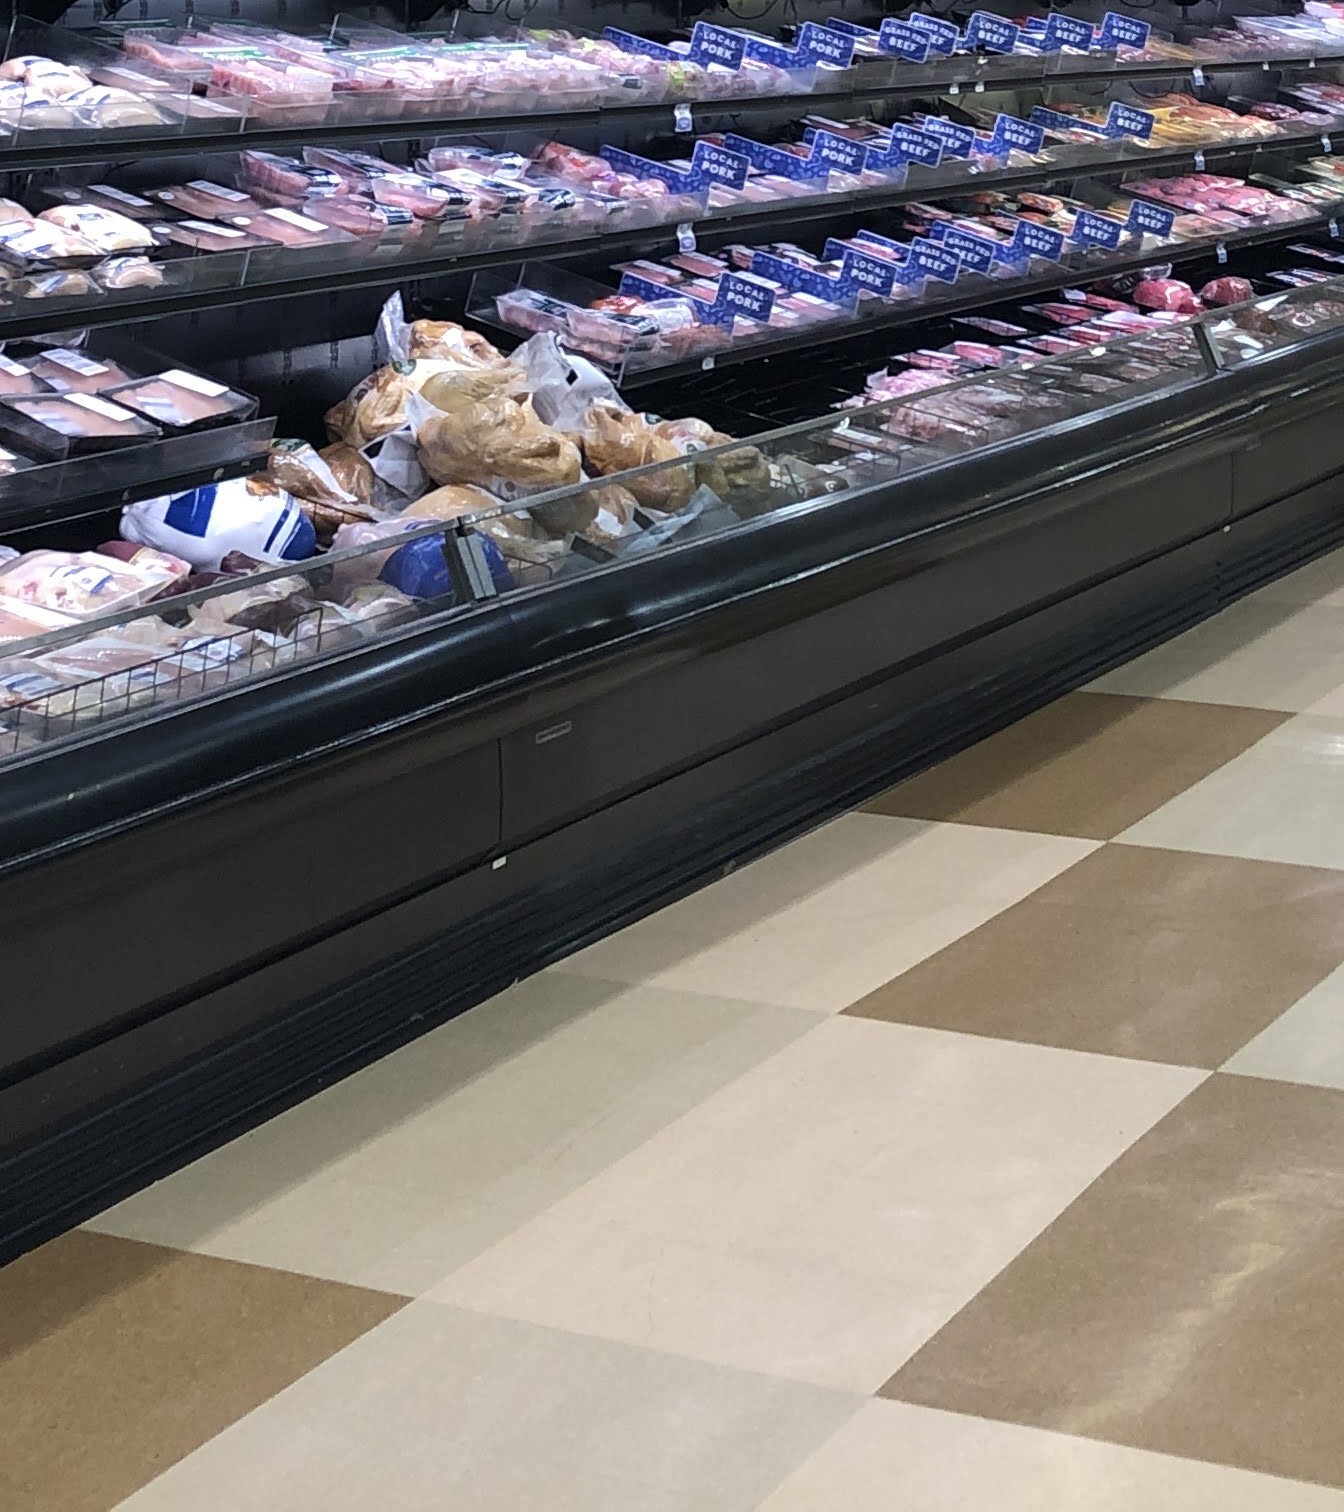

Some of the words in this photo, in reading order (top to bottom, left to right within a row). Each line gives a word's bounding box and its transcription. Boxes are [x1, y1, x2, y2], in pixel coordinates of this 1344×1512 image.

[978, 20, 1010, 37] LOCAL
[1056, 20, 1087, 35] LOCAL
[1113, 18, 1141, 34] LOCAL
[703, 31, 737, 49] LOCAL
[811, 30, 845, 48] LOCAL
[977, 29, 1007, 45] BEEF
[1055, 29, 1082, 43] BEEF
[1111, 28, 1138, 41] BEEF
[700, 41, 734, 60] PORK
[809, 40, 842, 59] PORK
[889, 37, 917, 52] BEEF
[1117, 108, 1147, 123] LOCAL
[1005, 122, 1036, 139] LOCAL
[1116, 117, 1144, 132] BEEF
[823, 137, 856, 155] LOCAL
[1004, 131, 1032, 146] BEEF
[821, 147, 854, 166] PORK
[900, 141, 931, 158] BEEF
[703, 149, 739, 169] LOCAL
[701, 161, 736, 180] PORK
[1138, 206, 1168, 222] LOCAL
[1084, 217, 1117, 233] LOCAL
[1137, 215, 1163, 230] BEEF
[1024, 227, 1056, 243] LOCAL
[1083, 226, 1110, 241] BEEF
[1023, 236, 1052, 252] BEEF
[853, 258, 886, 276] LOCAL
[918, 256, 947, 272] BEEF
[850, 269, 883, 287] PORK
[729, 280, 764, 300] LOCAL
[727, 292, 762, 312] PORK
